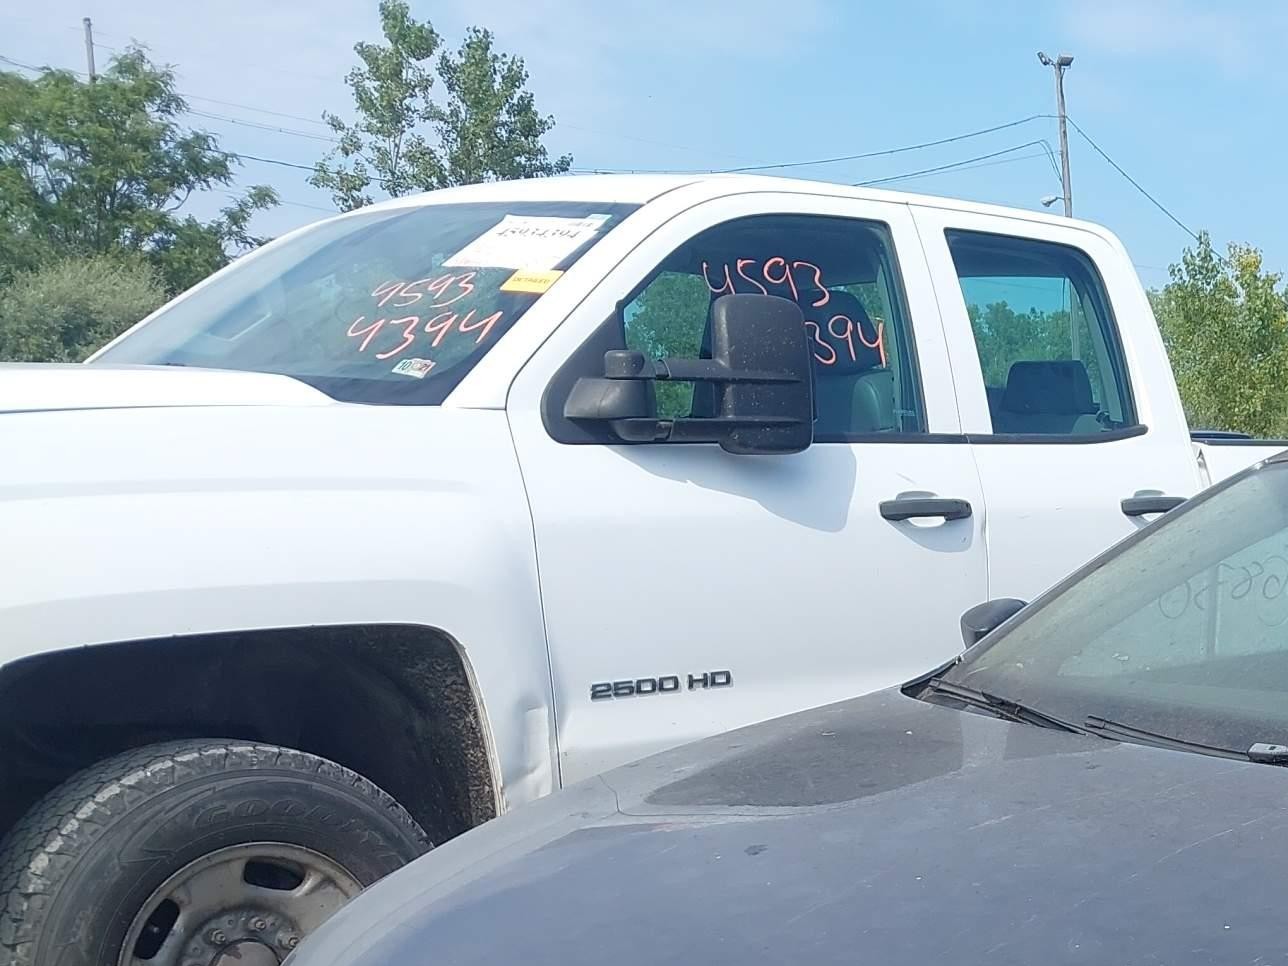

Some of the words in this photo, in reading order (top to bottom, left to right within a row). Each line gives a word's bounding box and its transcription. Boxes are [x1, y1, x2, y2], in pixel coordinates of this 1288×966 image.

[371, 271, 477, 308] 4593
[702, 257, 830, 307] 4593
[347, 309, 504, 359] 4394
[590, 675, 680, 700] 2500
[687, 670, 732, 690] HD
